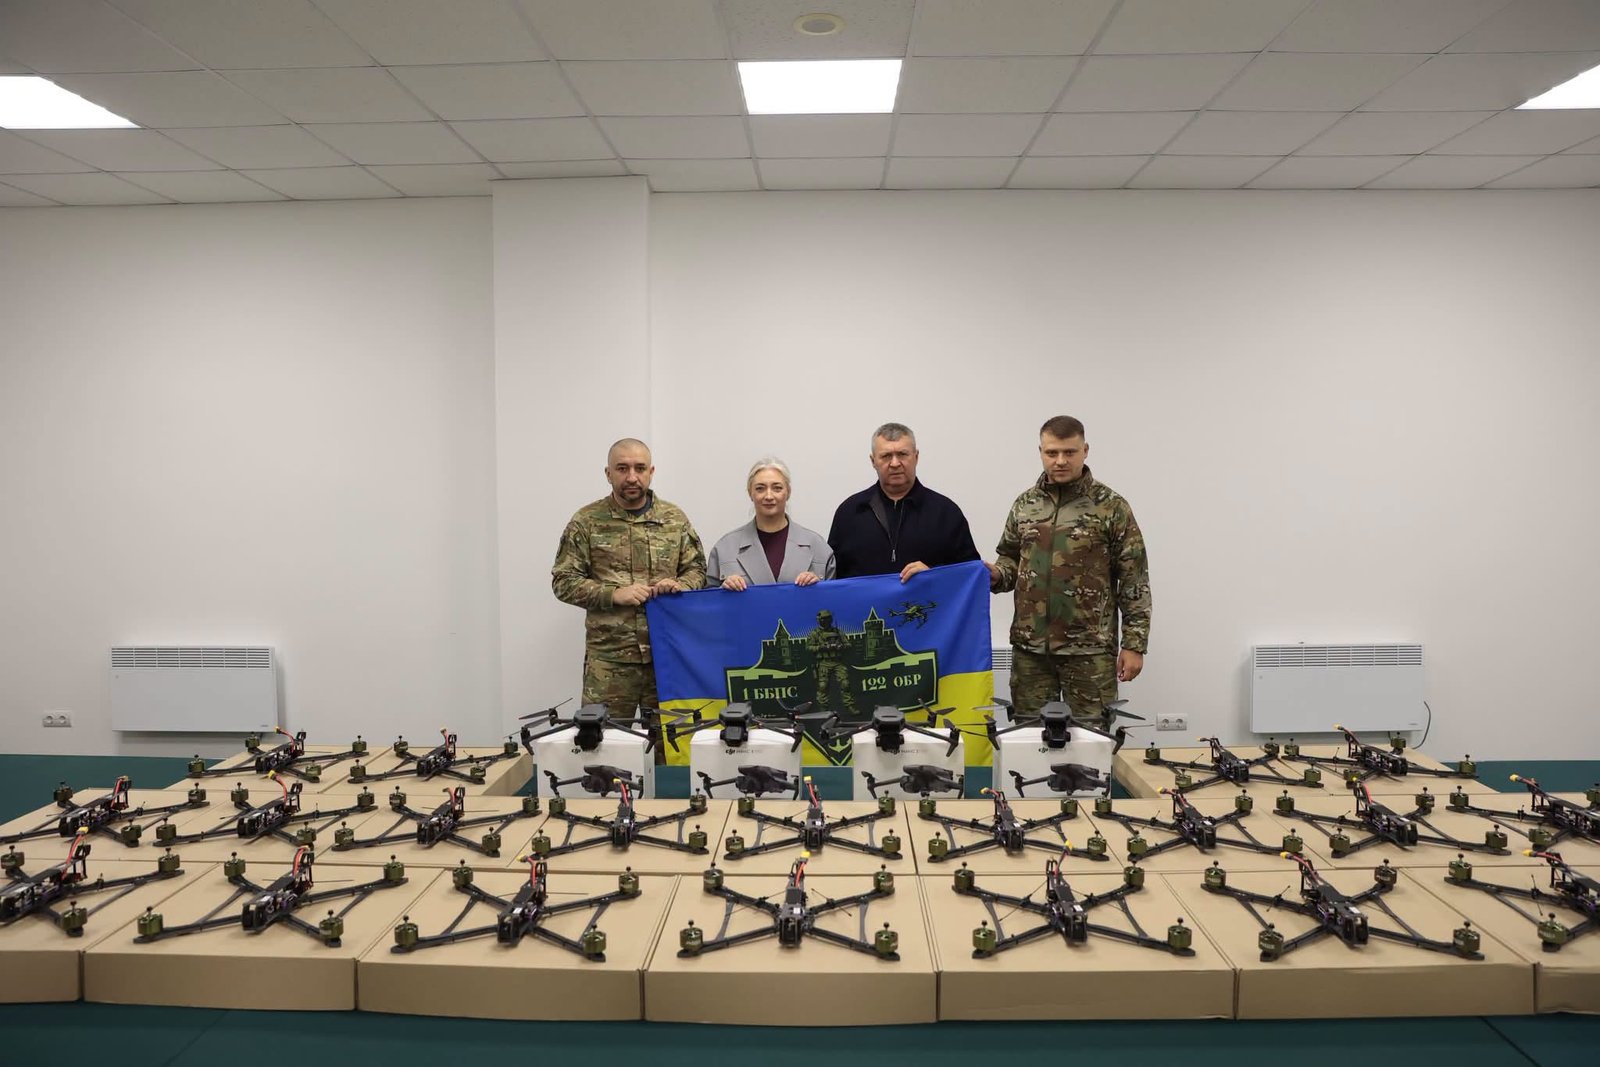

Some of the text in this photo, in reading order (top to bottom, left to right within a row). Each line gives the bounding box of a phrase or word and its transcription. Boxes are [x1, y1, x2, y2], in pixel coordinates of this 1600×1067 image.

[861, 673, 922, 692] 122 ОБР
[754, 686, 799, 700] ББПС
